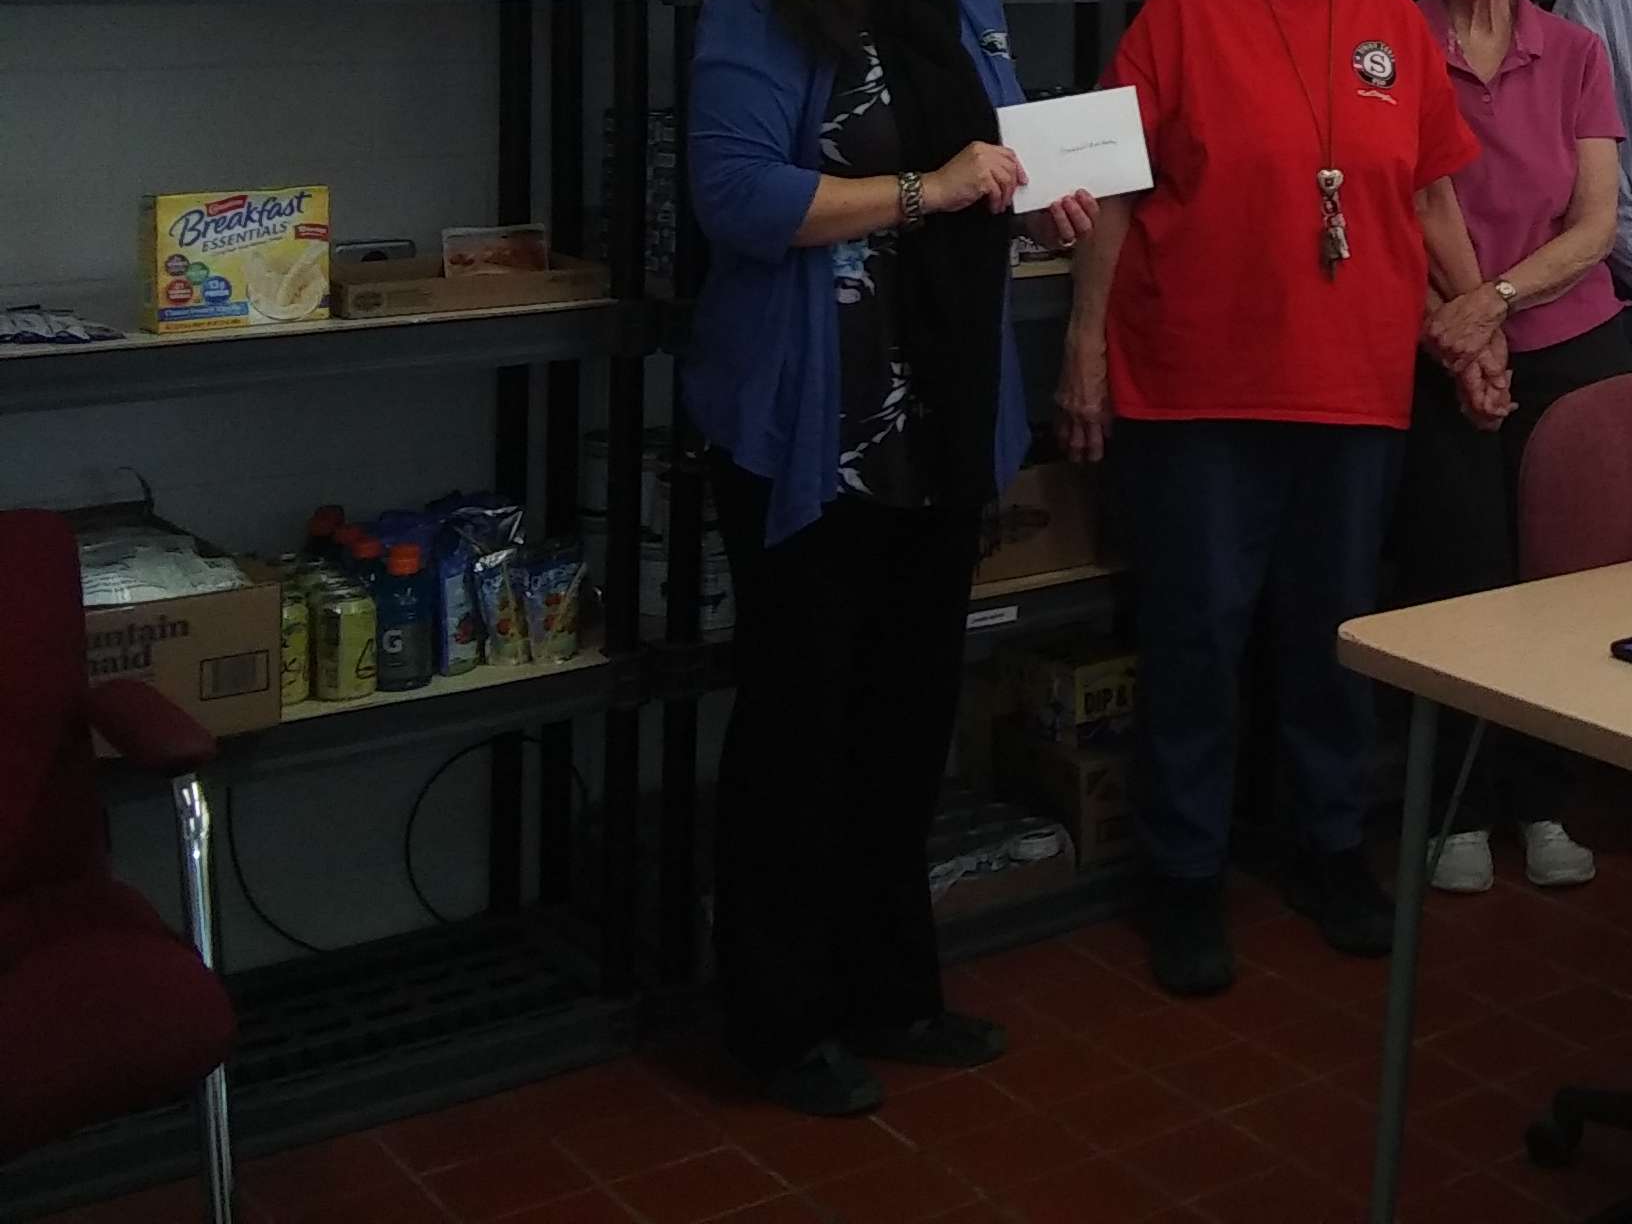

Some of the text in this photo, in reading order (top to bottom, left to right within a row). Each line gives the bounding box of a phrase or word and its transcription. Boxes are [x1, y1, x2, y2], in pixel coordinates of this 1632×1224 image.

[1370, 54, 1386, 74] S
[169, 191, 313, 247] Breakfast
[202, 220, 288, 253] ESSENTIALS
[88, 614, 190, 648] untain
[382, 628, 402, 654] G
[1084, 687, 1112, 717] DIP
